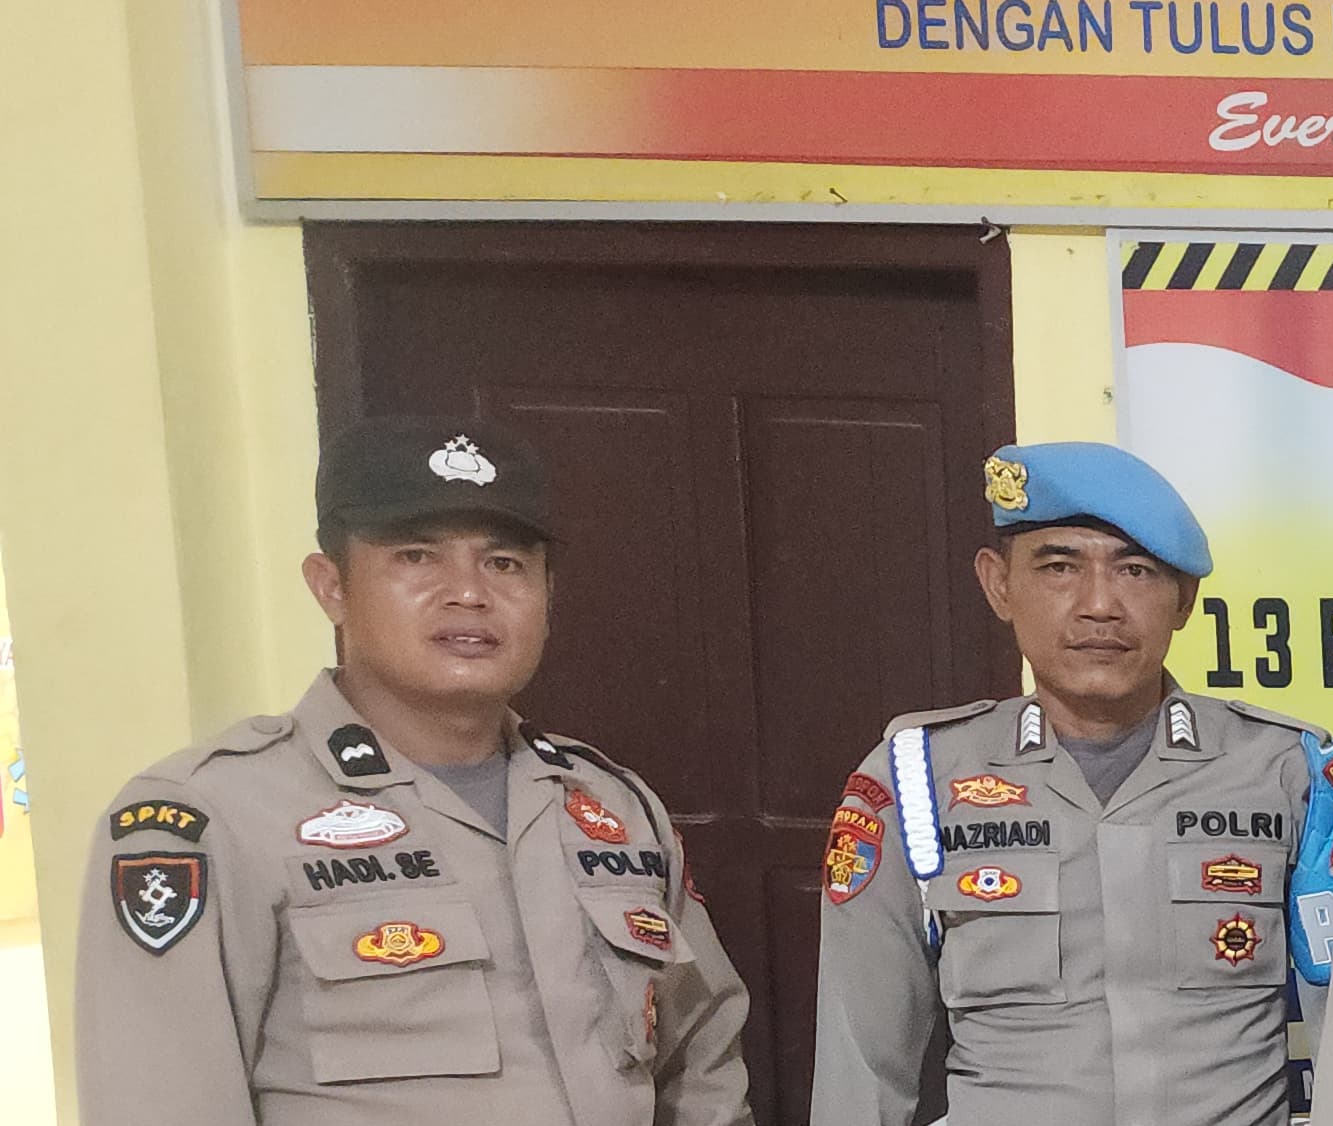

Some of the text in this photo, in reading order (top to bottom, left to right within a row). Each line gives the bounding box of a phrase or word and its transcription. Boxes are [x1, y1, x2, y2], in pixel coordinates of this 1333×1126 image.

[877, 0, 1114, 53] DENGAN
[1130, 1, 1314, 56] TULUS
[1202, 597, 1293, 688] 13
[119, 805, 197, 829] SPKT
[1176, 811, 1283, 840] POLRI
